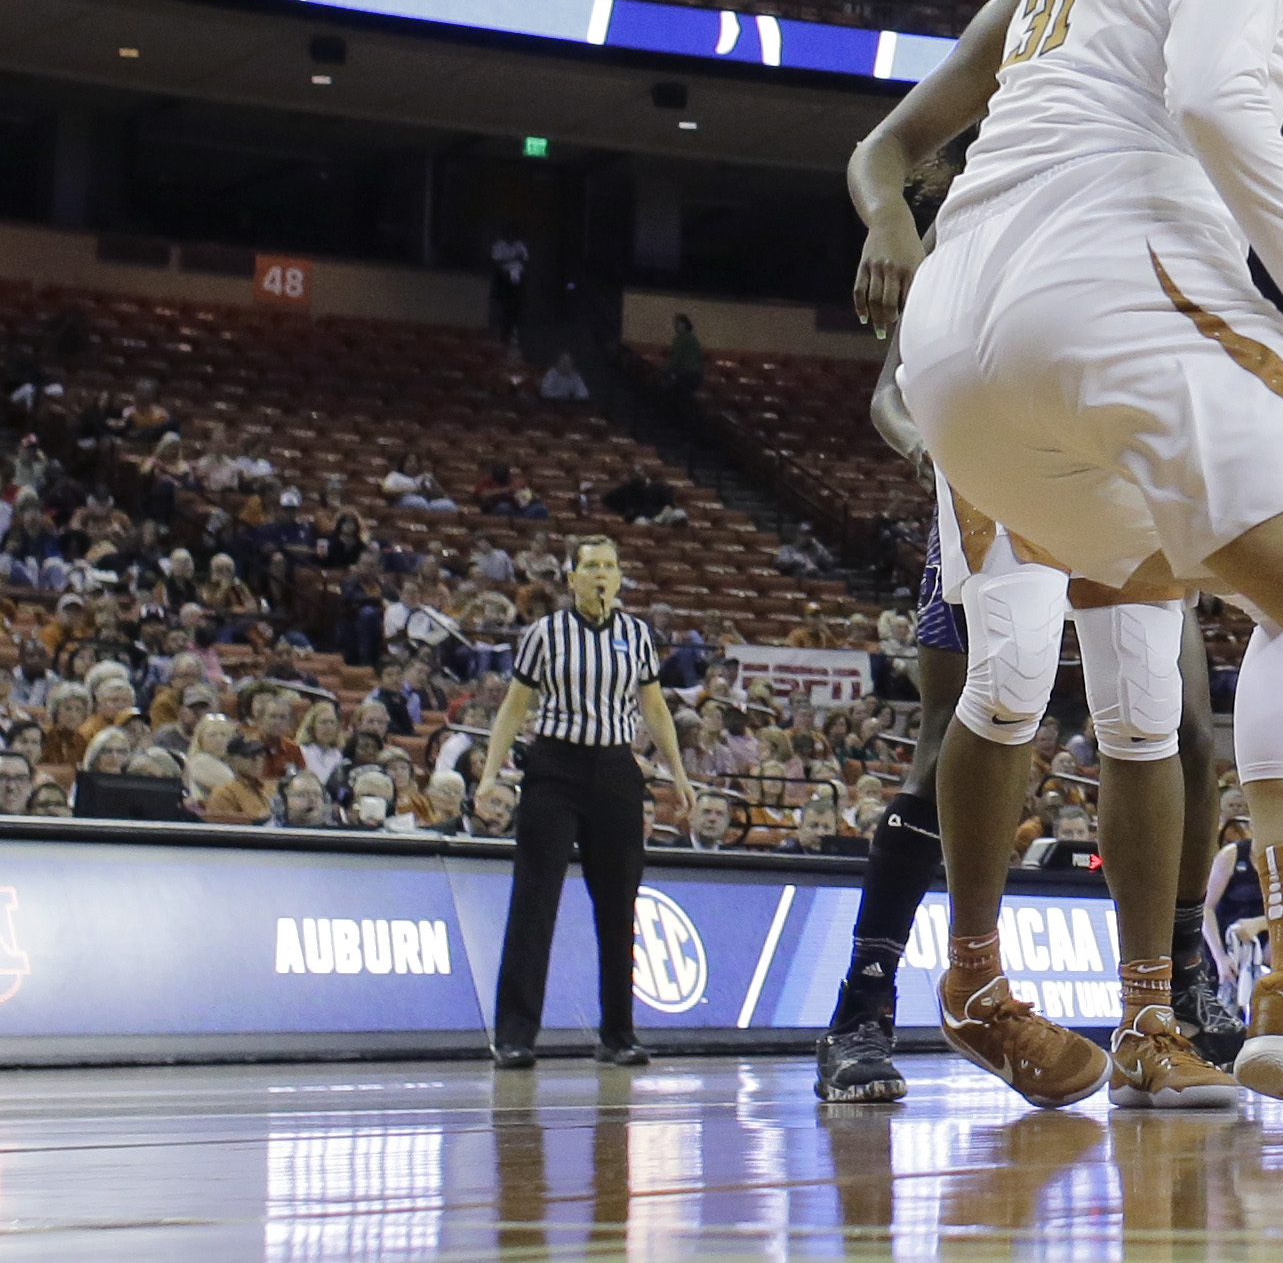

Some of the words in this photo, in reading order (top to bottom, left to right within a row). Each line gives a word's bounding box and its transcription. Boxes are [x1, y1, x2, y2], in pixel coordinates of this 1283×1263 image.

[262, 266, 304, 298] 48
[276, 917, 452, 975] AUBURN
[997, 907, 1105, 972] NCAA
[1042, 981, 1074, 1017] BY
